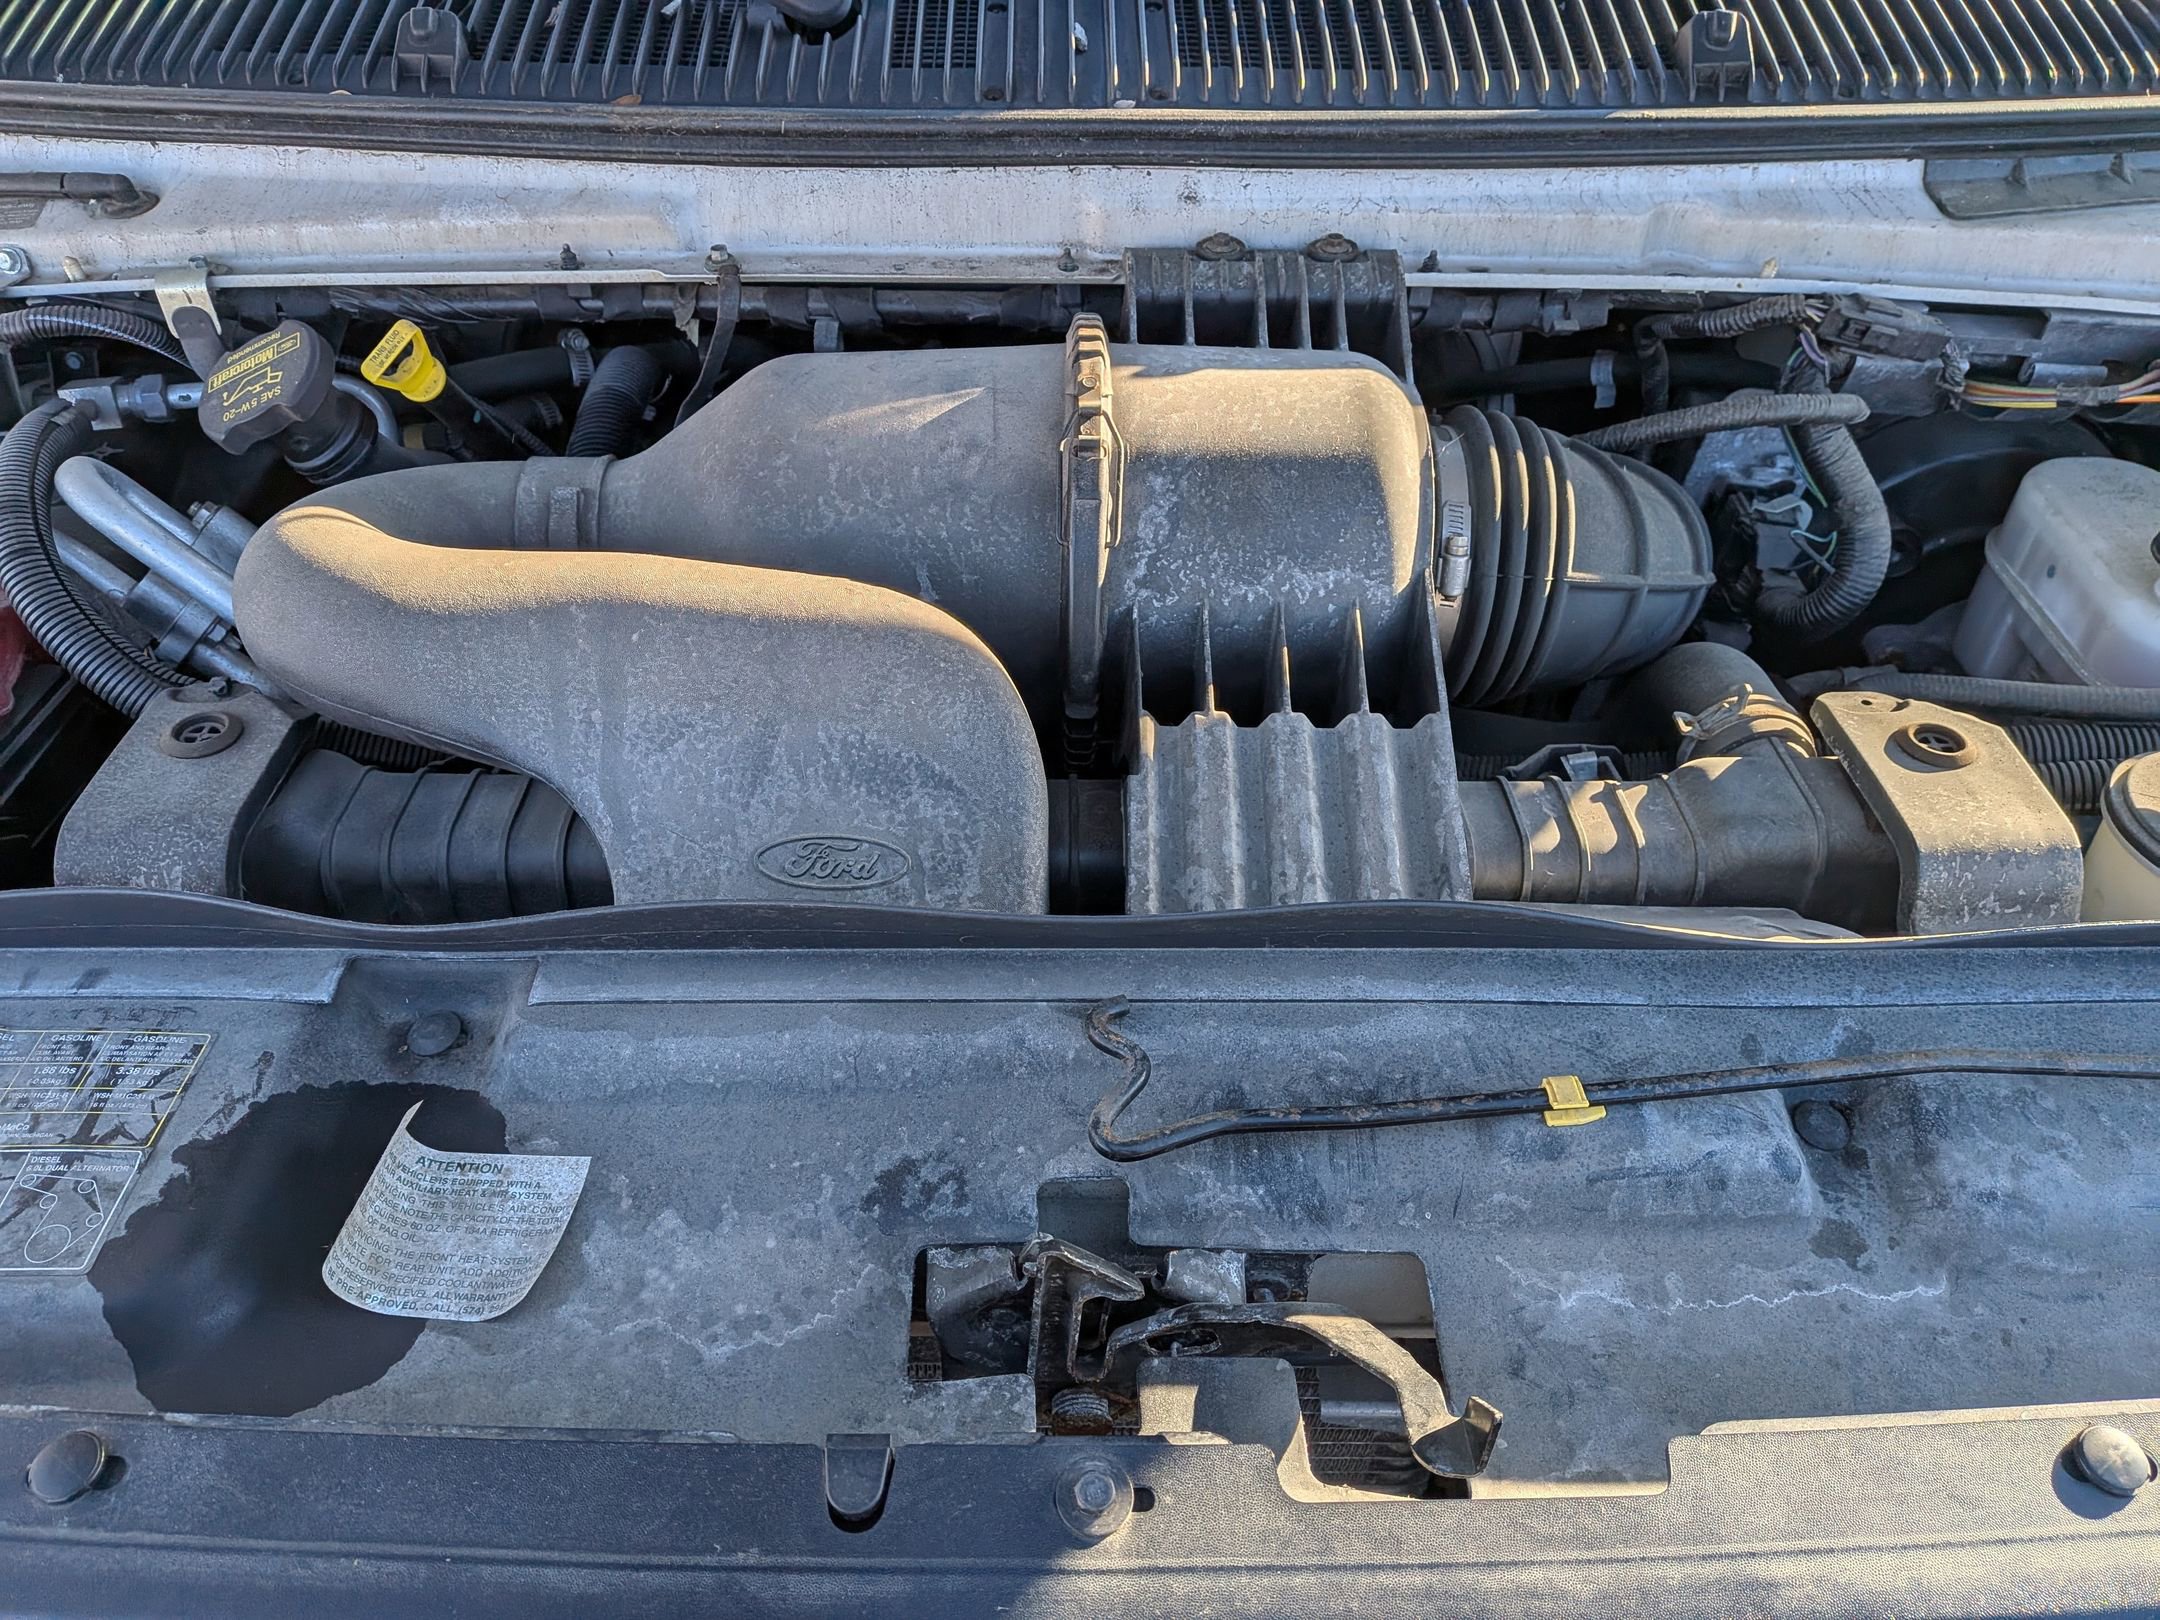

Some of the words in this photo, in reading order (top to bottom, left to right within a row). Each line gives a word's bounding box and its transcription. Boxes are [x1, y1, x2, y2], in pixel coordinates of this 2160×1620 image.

[227, 331, 281, 363] Recommended
[369, 342, 388, 364] TRANS
[385, 328, 400, 345] FLUID
[214, 346, 275, 387] Motorcraft
[260, 385, 281, 403] SAE
[222, 397, 257, 422] 5W-20
[785, 842, 881, 880] Ford
[51, 1034, 104, 1042] GASOLINE
[133, 1035, 187, 1043] GASOLINE
[58, 1066, 77, 1074] lbs
[142, 1067, 162, 1076] lbs
[397, 1161, 437, 1183] VEHICLE
[438, 1177, 449, 1186] IS
[451, 1178, 503, 1188] EQUIPPED
[506, 1180, 532, 1190] WITH
[533, 1181, 541, 1190] A
[415, 1156, 504, 1174] ATTENTION
[376, 1174, 417, 1205] ERVICING
[421, 1198, 447, 1210] THIS
[451, 1200, 506, 1213] VEHICLE'S
[508, 1204, 527, 1214] AIR
[396, 1175, 450, 1196] AUXILIARY
[451, 1188, 478, 1198] HEAT
[480, 1190, 488, 1198] &
[490, 1189, 510, 1199] AIR
[373, 1185, 400, 1212] PLEASE
[400, 1205, 428, 1220] NOTE
[430, 1211, 449, 1221] THE
[449, 1213, 500, 1223] CAPACITY
[499, 1216, 514, 1225] OF
[515, 1217, 536, 1226] THE
[367, 1215, 379, 1227] OF
[379, 1222, 400, 1238] PAG
[445, 1225, 461, 1234] OF
[464, 1226, 488, 1236] 134A
[352, 1224, 390, 1253] ERVICING
[394, 1247, 417, 1260] THE
[418, 1251, 457, 1263] FRONT
[457, 1254, 488, 1265] HEAT
[343, 1247, 380, 1276] FACTORY
[381, 1271, 436, 1286] SPECIFIED
[369, 1252, 391, 1267] FOR
[395, 1262, 426, 1274] REAR
[459, 1267, 484, 1278] ADD
[326, 1265, 336, 1281] BE
[423, 1302, 454, 1313] CALL
[458, 1303, 486, 1316] (574)
[344, 1267, 397, 1296] RESERVOIR
[431, 1290, 452, 1301] ALL
